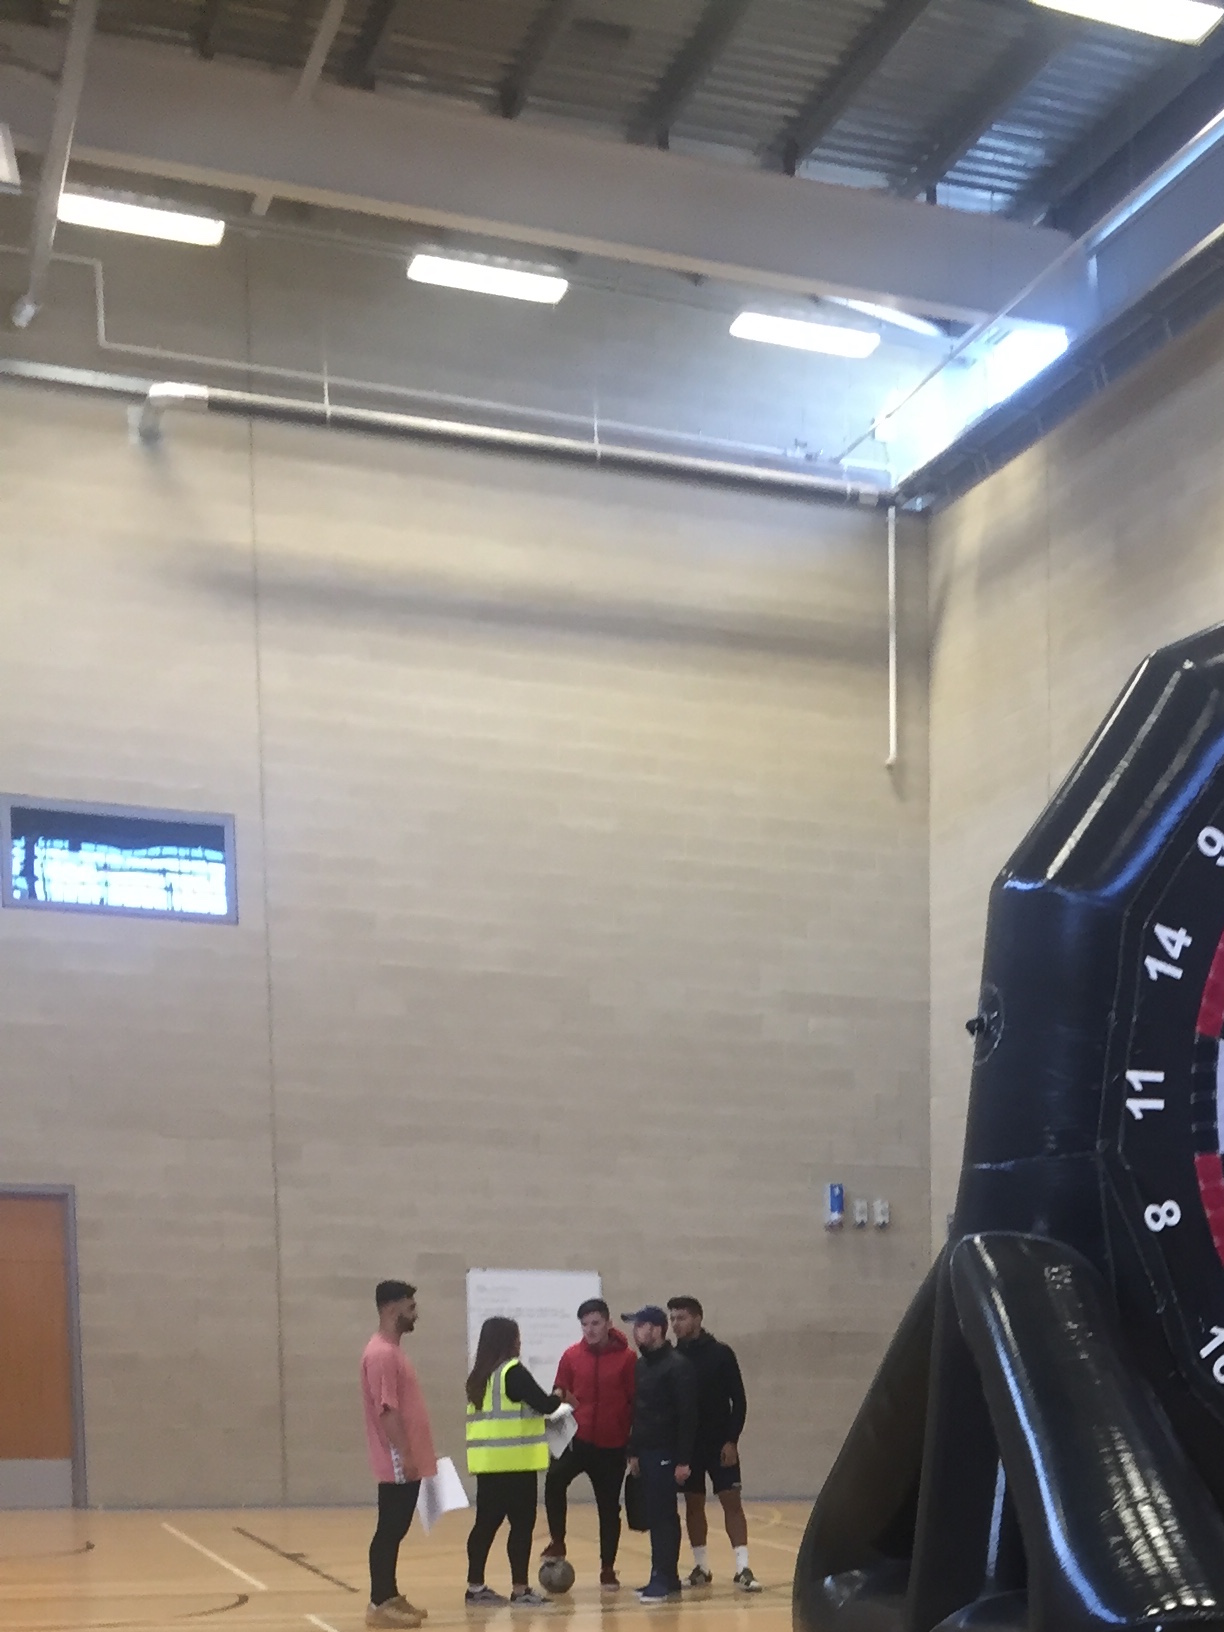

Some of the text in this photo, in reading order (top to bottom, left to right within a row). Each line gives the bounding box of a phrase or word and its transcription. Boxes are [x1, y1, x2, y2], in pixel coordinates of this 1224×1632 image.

[1143, 922, 1193, 981] 14
[1125, 1069, 1165, 1120] 11
[1143, 1199, 1182, 1232] 8
